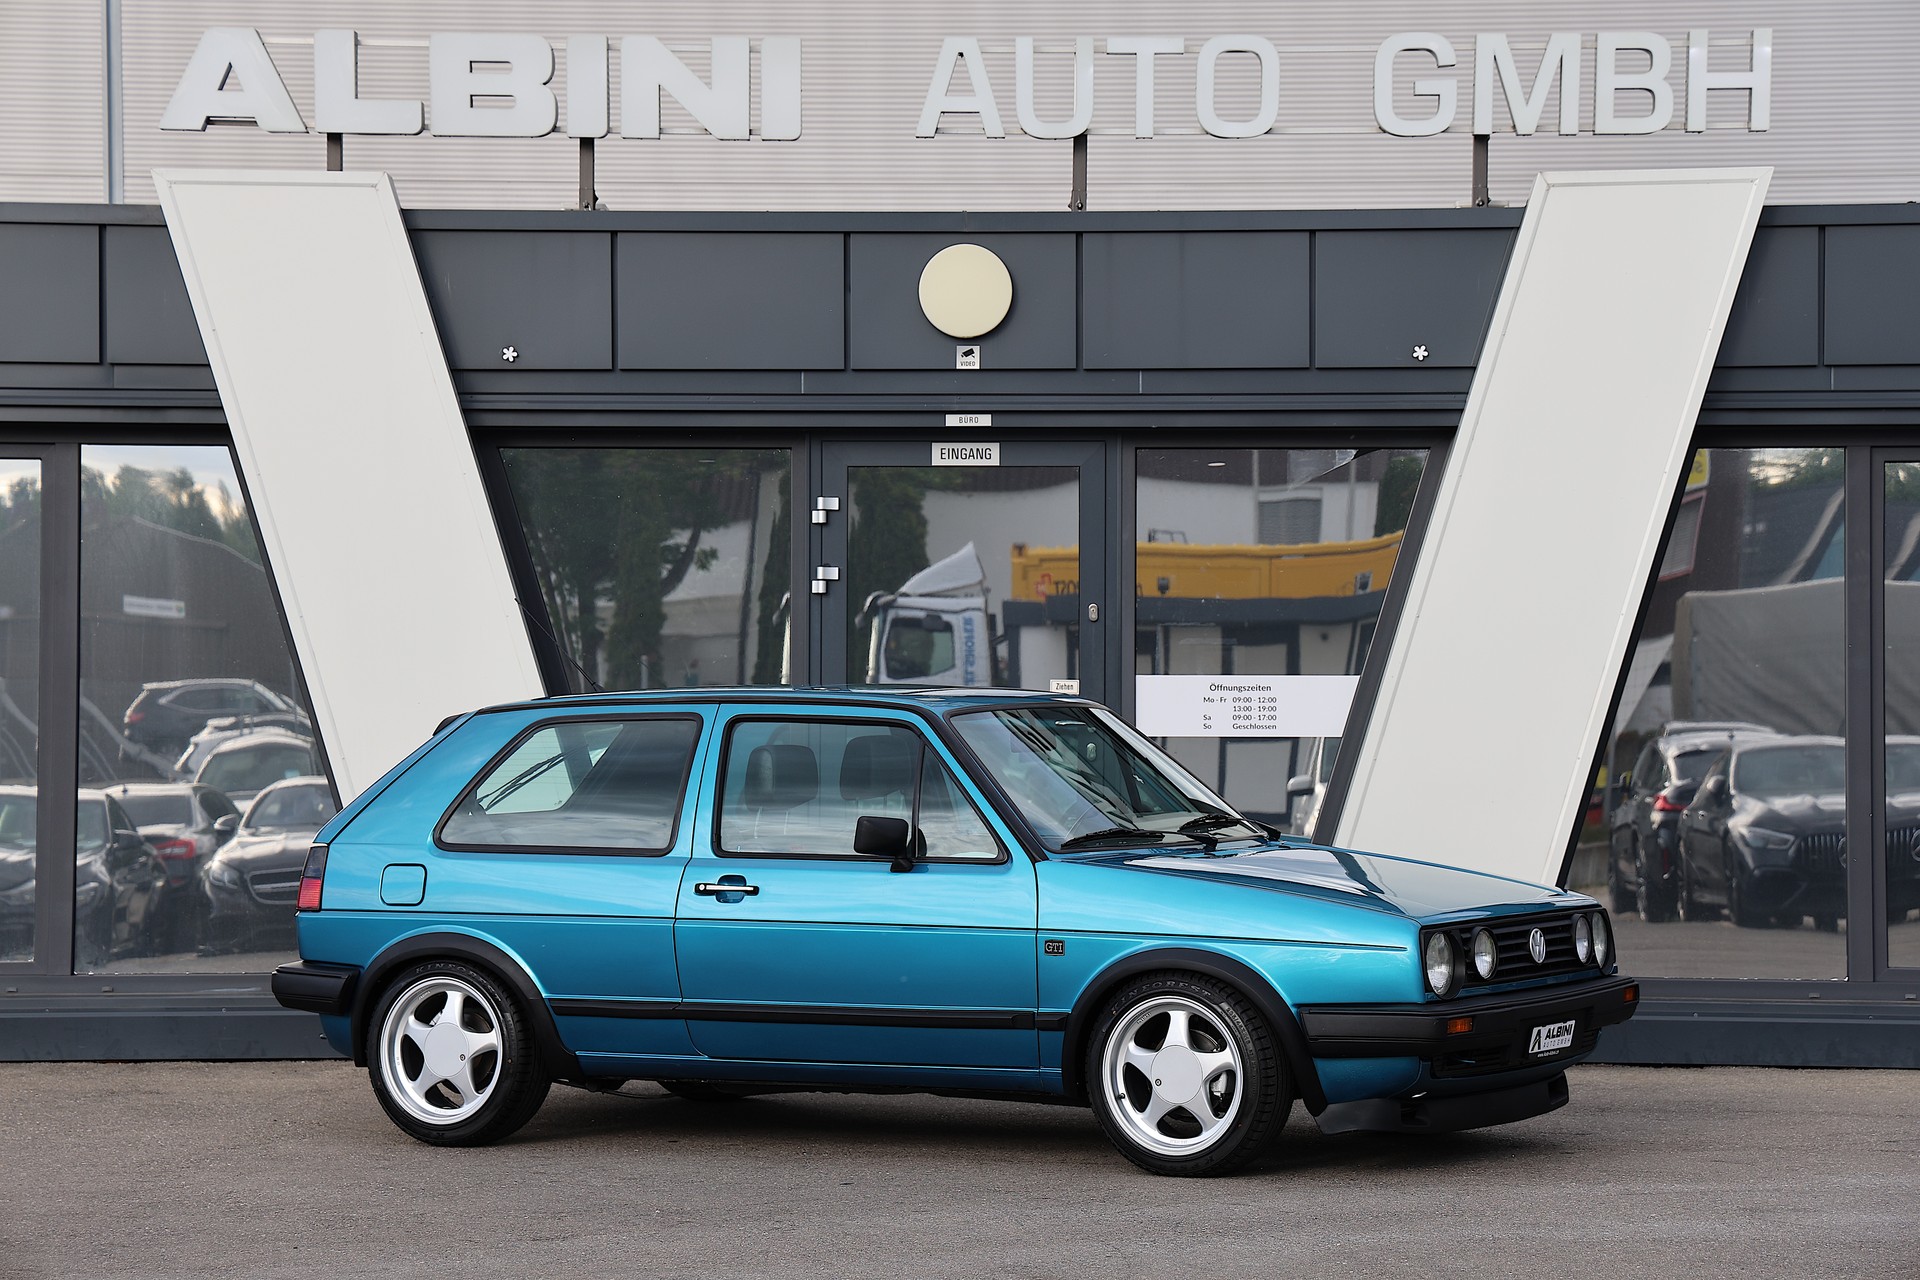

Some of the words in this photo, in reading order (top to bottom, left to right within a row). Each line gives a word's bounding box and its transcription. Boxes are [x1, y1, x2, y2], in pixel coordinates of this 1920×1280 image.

[159, 27, 802, 141] ALBINI
[915, 34, 1281, 139] AUTO
[1373, 28, 1773, 136] GMBH
[958, 416, 979, 424] BÜRO
[940, 447, 992, 460] EINGANG
[1209, 682, 1272, 693] Öffnungszeiten
[1045, 942, 1063, 952] GTI
[1544, 1023, 1574, 1040] ALBINI
